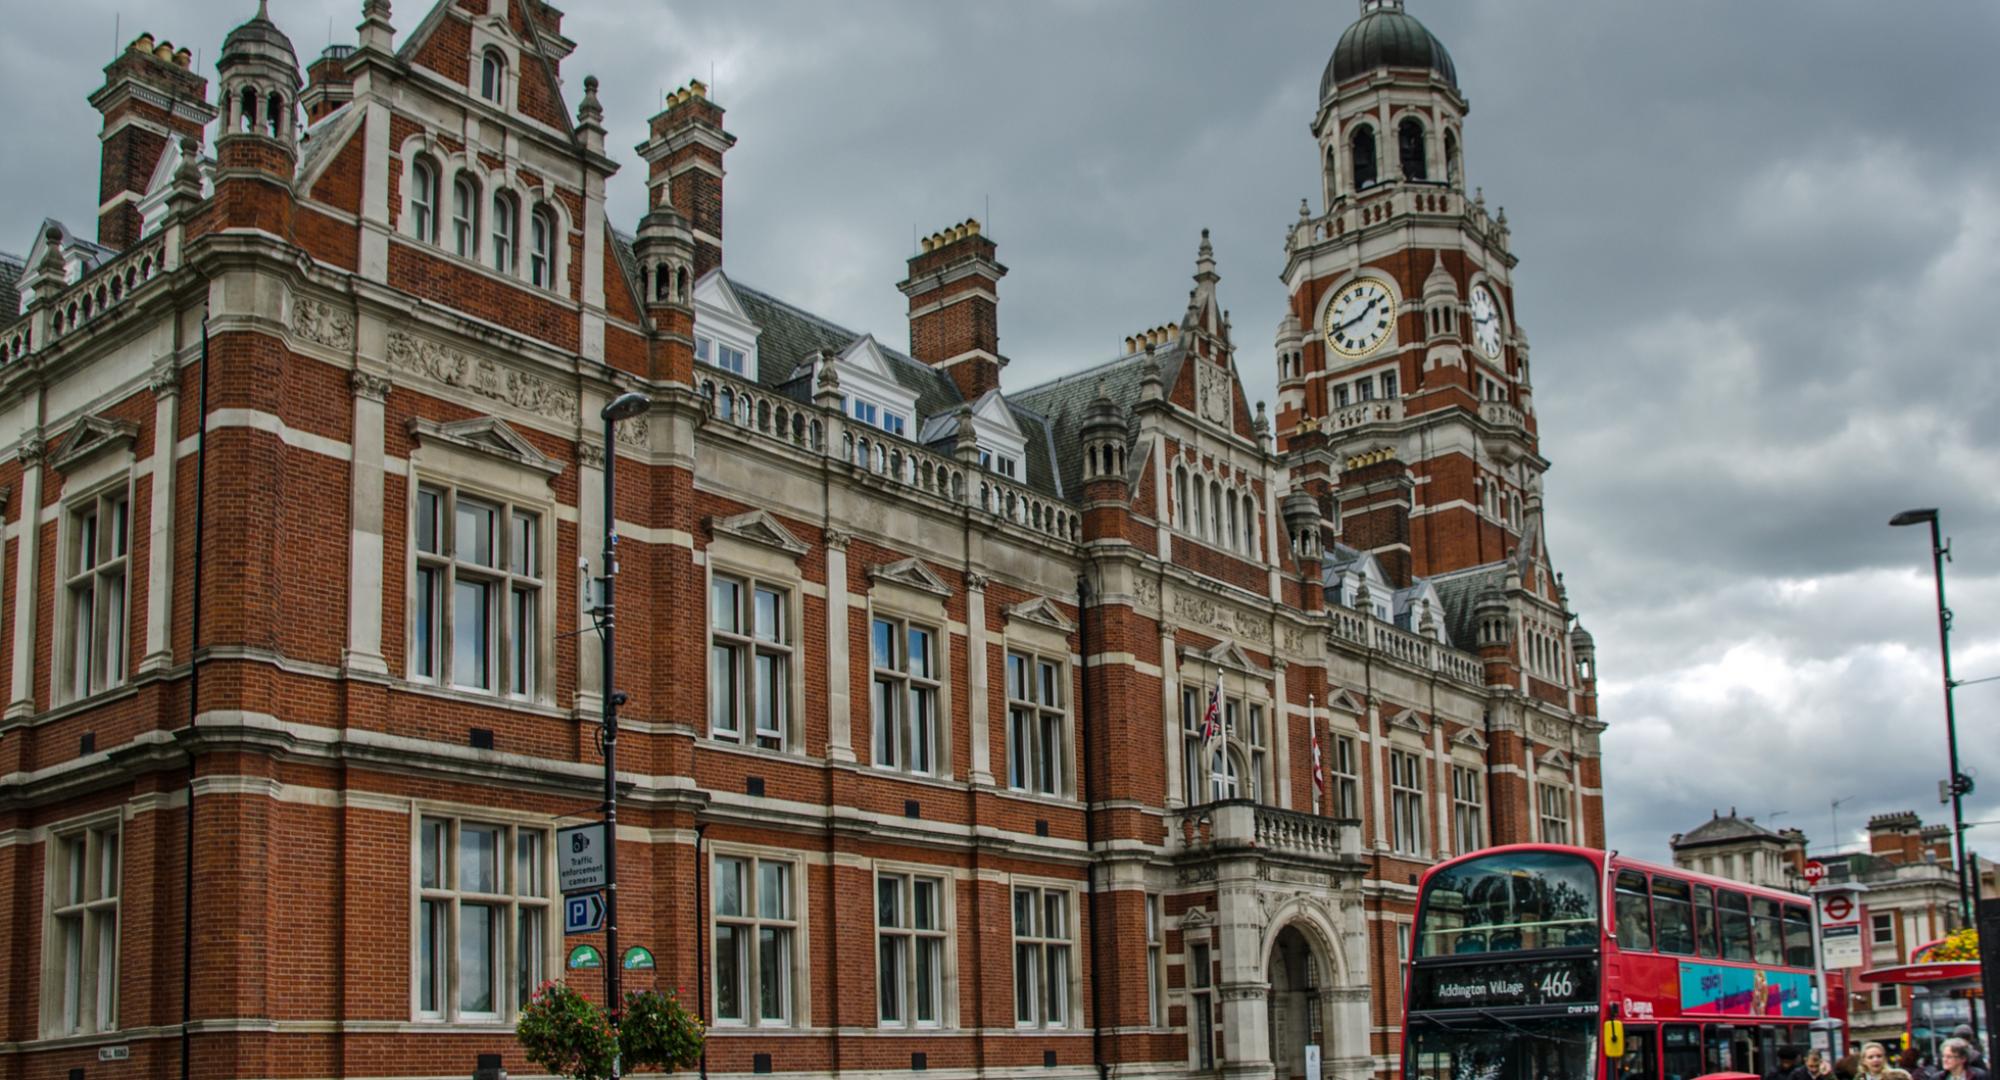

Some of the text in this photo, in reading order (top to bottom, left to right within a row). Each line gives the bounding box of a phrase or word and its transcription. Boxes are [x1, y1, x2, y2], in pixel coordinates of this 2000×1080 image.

[571, 856, 592, 866] Traffic
[562, 864, 603, 877] enforcement
[569, 876, 597, 886] cameras
[573, 903, 584, 924] P
[1438, 980, 1524, 998] Addington Village
[1540, 971, 1573, 997] 466
